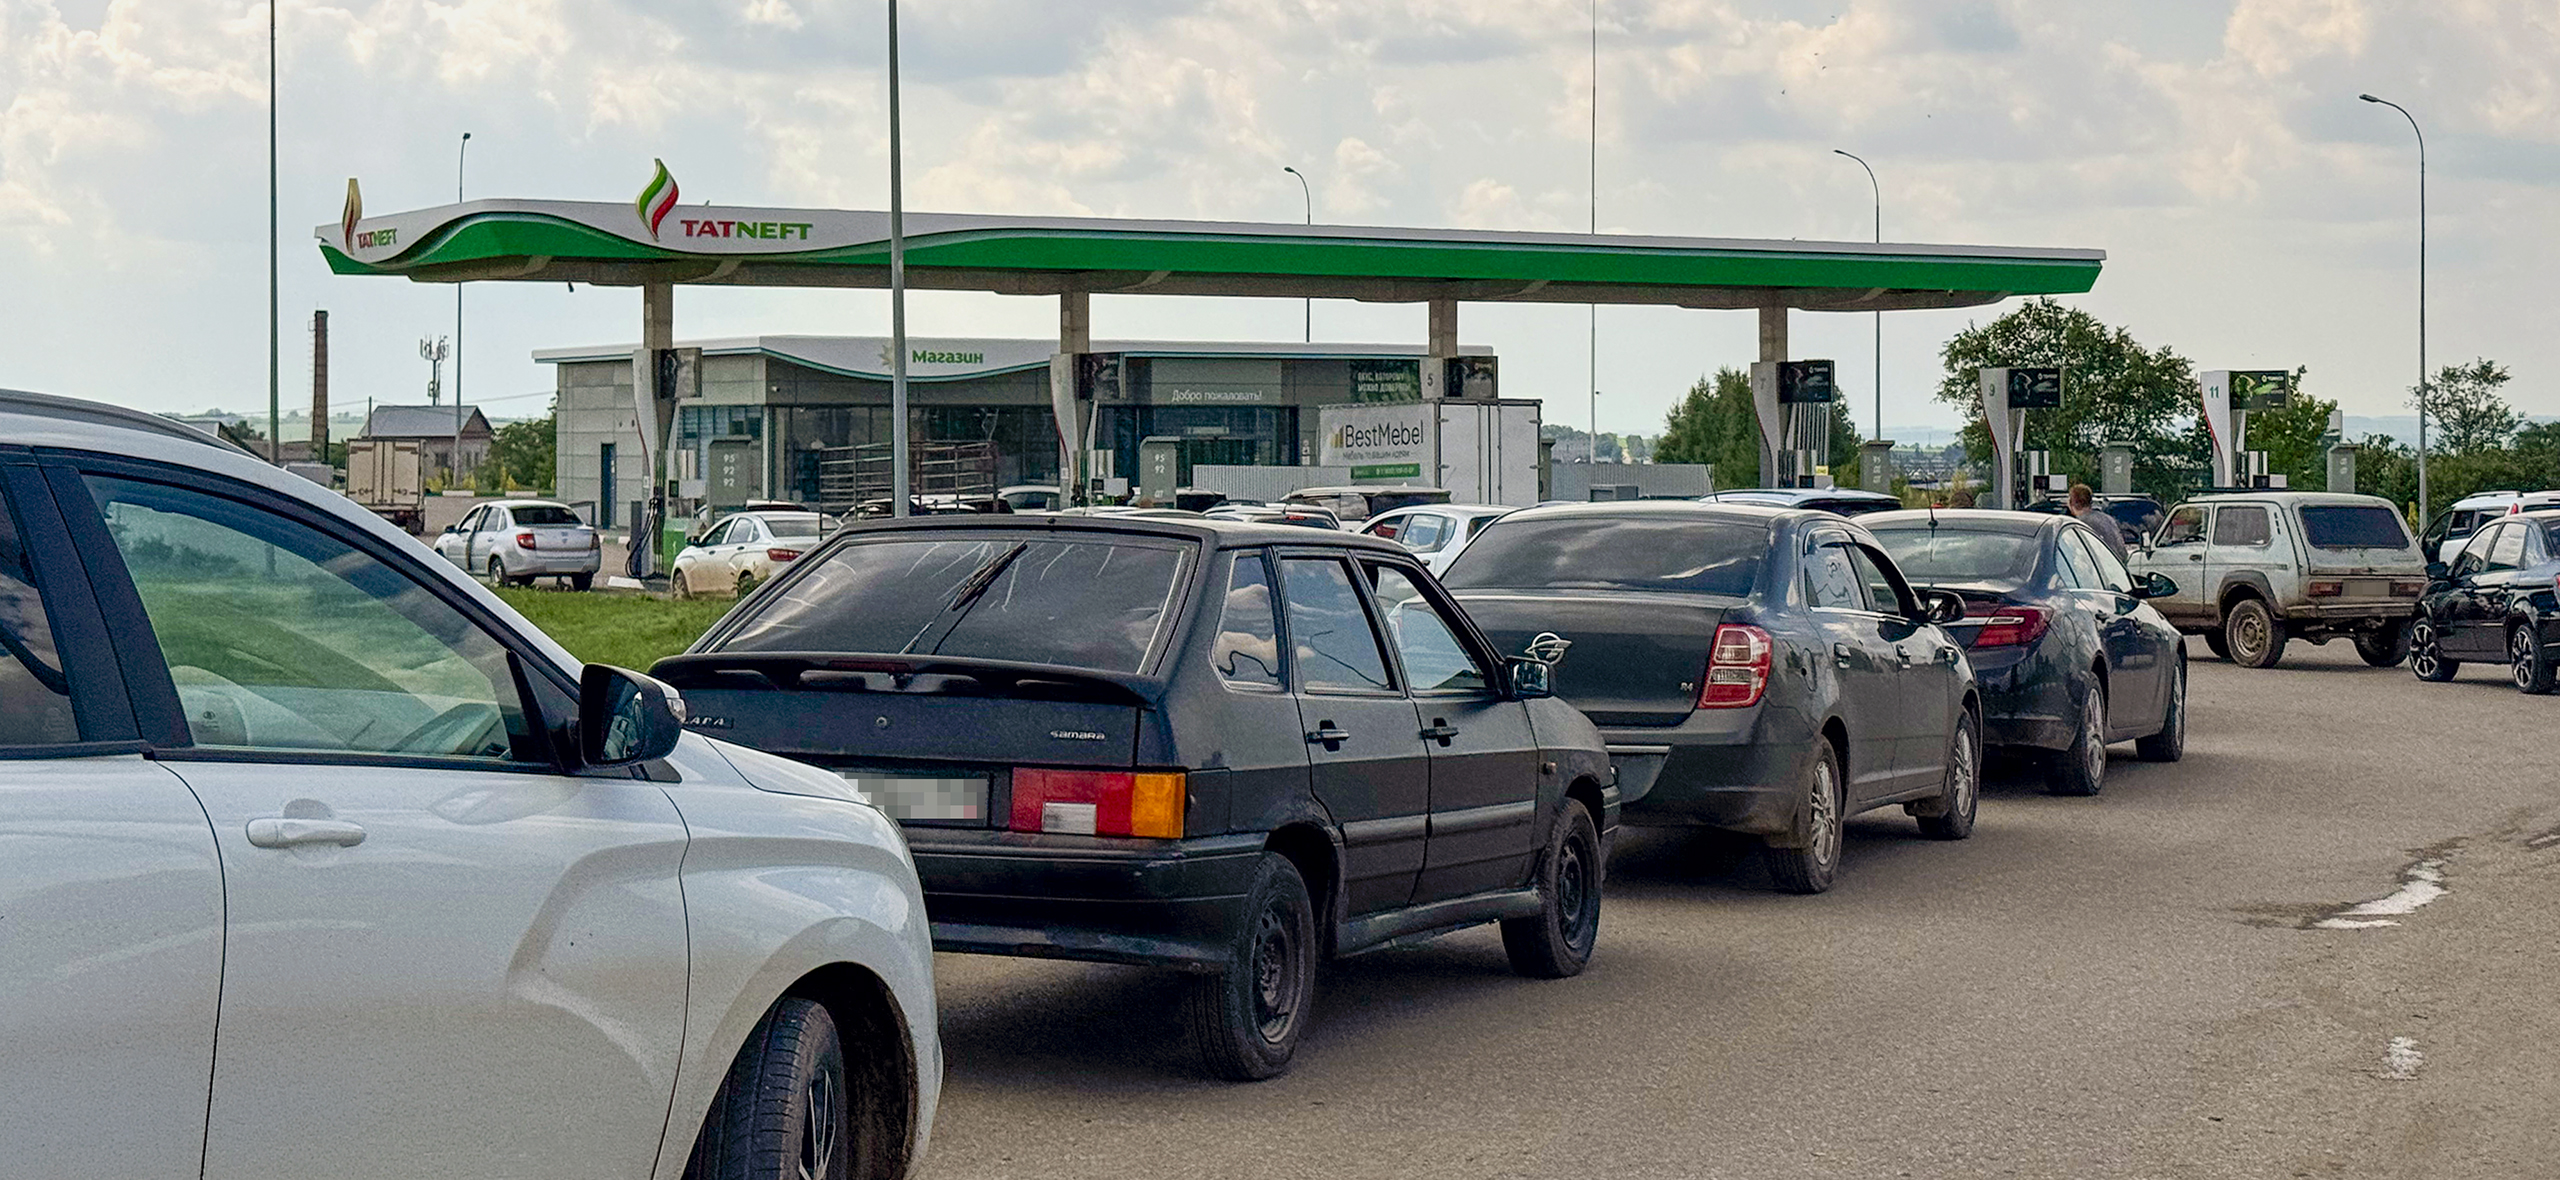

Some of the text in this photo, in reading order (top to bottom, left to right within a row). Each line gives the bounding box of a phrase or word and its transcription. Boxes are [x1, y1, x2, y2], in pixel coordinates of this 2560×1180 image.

[680, 219, 813, 240] TATNEFT
[356, 227, 397, 249] TATNEFT
[912, 349, 984, 364] Магазин
[1426, 372, 1434, 387] 5
[1171, 389, 1262, 403] Добро пожаловать!
[1988, 383, 1996, 397] 9
[2209, 385, 2220, 399] 11
[1345, 419, 1424, 448] BestMebel
[723, 453, 735, 463] 95
[1154, 453, 1165, 463] 95
[723, 466, 735, 475] 92
[1154, 465, 1165, 474] 92
[723, 478, 735, 487] 92
